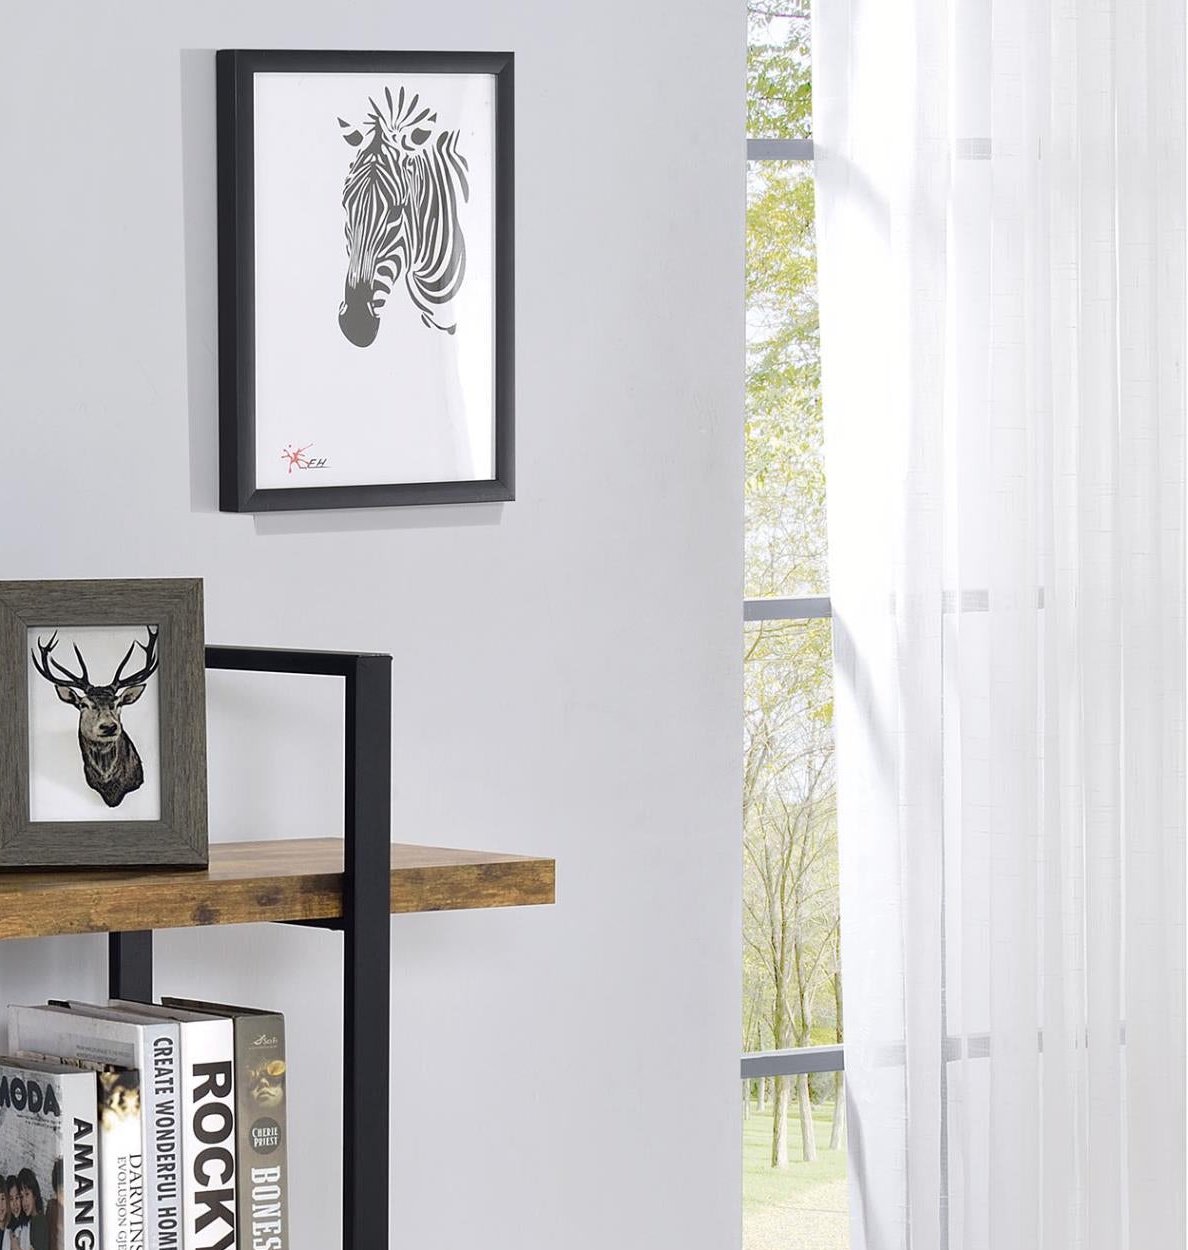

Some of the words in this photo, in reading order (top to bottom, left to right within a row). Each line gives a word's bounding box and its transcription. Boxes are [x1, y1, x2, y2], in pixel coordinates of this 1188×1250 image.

[153, 1036, 175, 1095] CREATE
[155, 1099, 177, 1201] WONDERFUL
[251, 1127, 278, 1138] CHERIE
[253, 1136, 278, 1148] PRIEST
